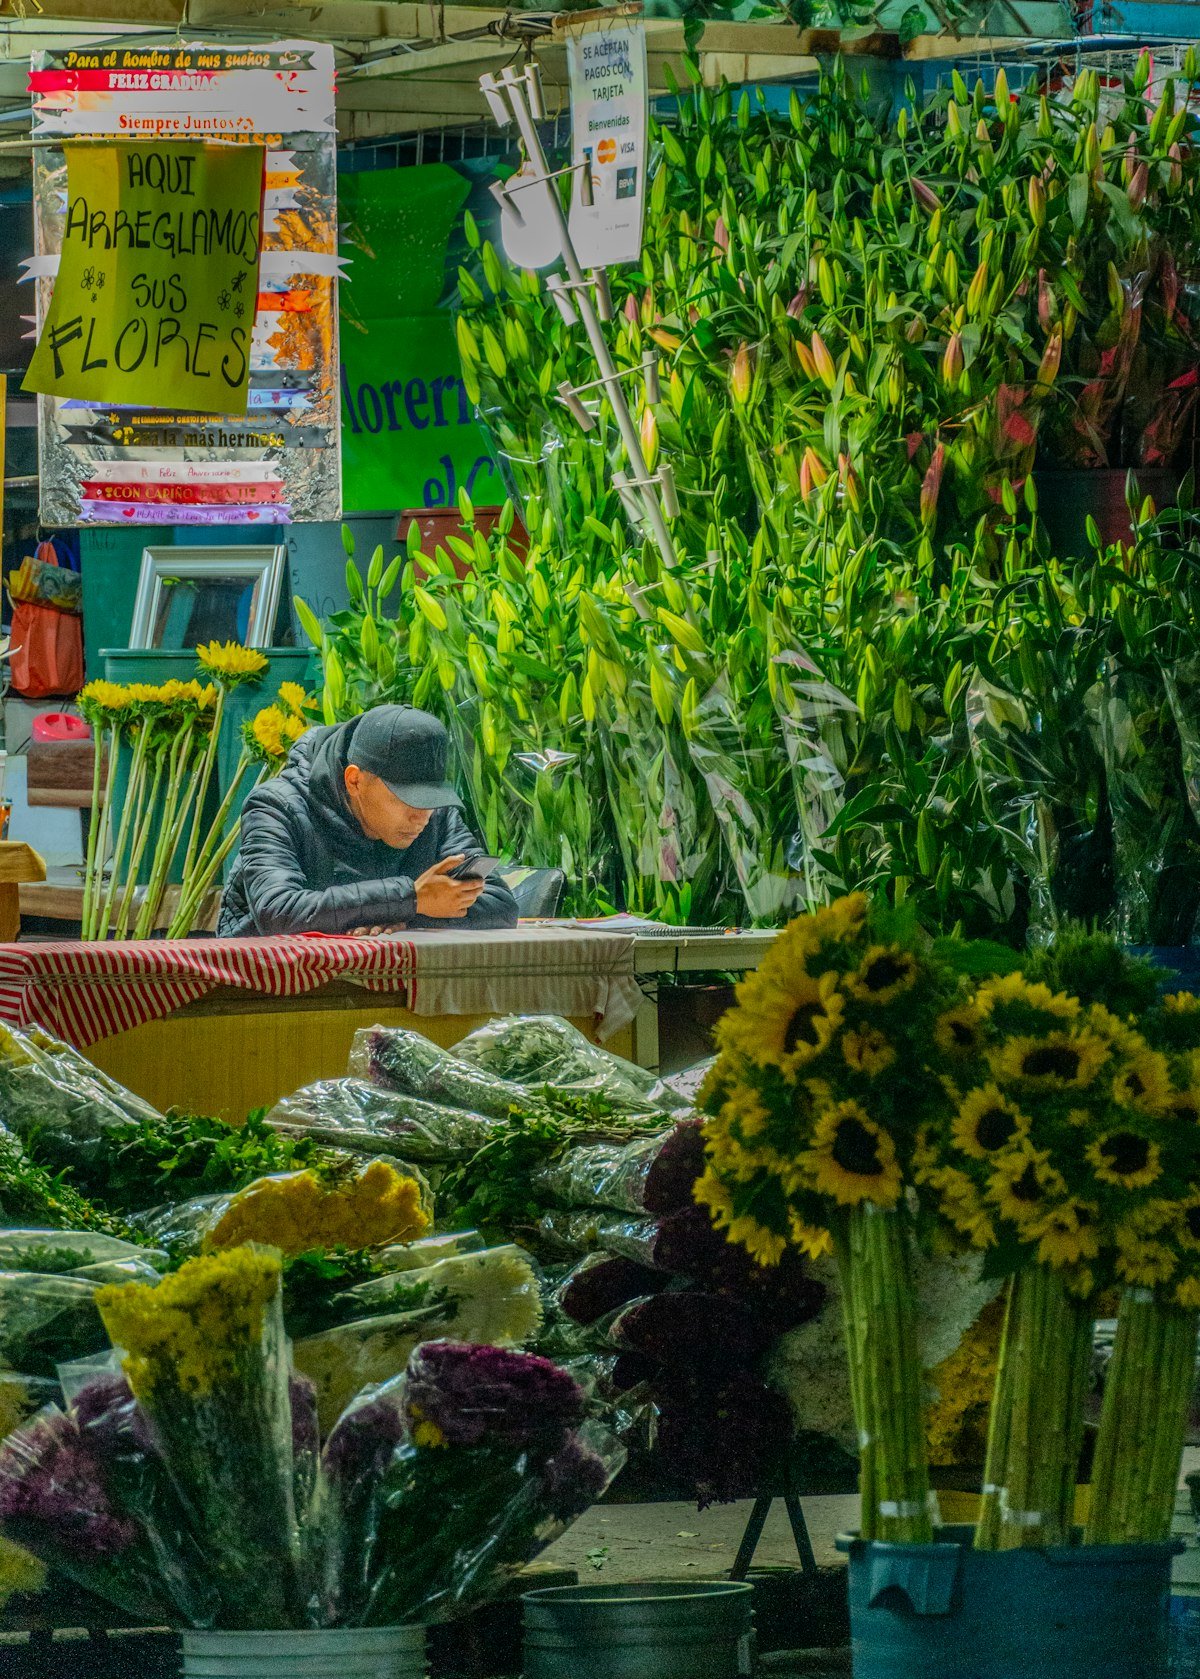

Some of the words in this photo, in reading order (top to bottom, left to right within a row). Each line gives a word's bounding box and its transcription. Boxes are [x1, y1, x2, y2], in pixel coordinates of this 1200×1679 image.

[67, 51, 99, 68] Para
[102, 50, 117, 66] el
[122, 50, 170, 68] hombre
[175, 50, 191, 67] de
[198, 54, 220, 67] mis
[225, 51, 270, 67] sueños
[583, 46, 592, 60] SE
[594, 40, 630, 57] ACEPTAN
[584, 64, 611, 80] PAGOS
[613, 61, 630, 75] CON
[108, 73, 149, 90] FELIZ
[150, 74, 220, 91] GRADUAC
[592, 83, 624, 101] TARJETA
[119, 114, 180, 134] Siempre
[183, 115, 234, 130] Juntos
[588, 115, 630, 132] Bienvenidas
[620, 142, 635, 154] VISA
[127, 152, 196, 196] AQUI
[618, 177, 634, 188] BBVA
[65, 196, 259, 265] ARREGLAMOS
[131, 273, 188, 313] SUS
[48, 315, 247, 388] FLORES
[123, 426, 159, 446] Para
[163, 428, 176, 446] la
[184, 426, 214, 447] más
[219, 429, 284, 447] hermosa
[159, 467, 176, 478] Feliz
[187, 466, 231, 478] Aniversario
[113, 486, 140, 499] CON
[145, 484, 193, 499] CARIÑO
